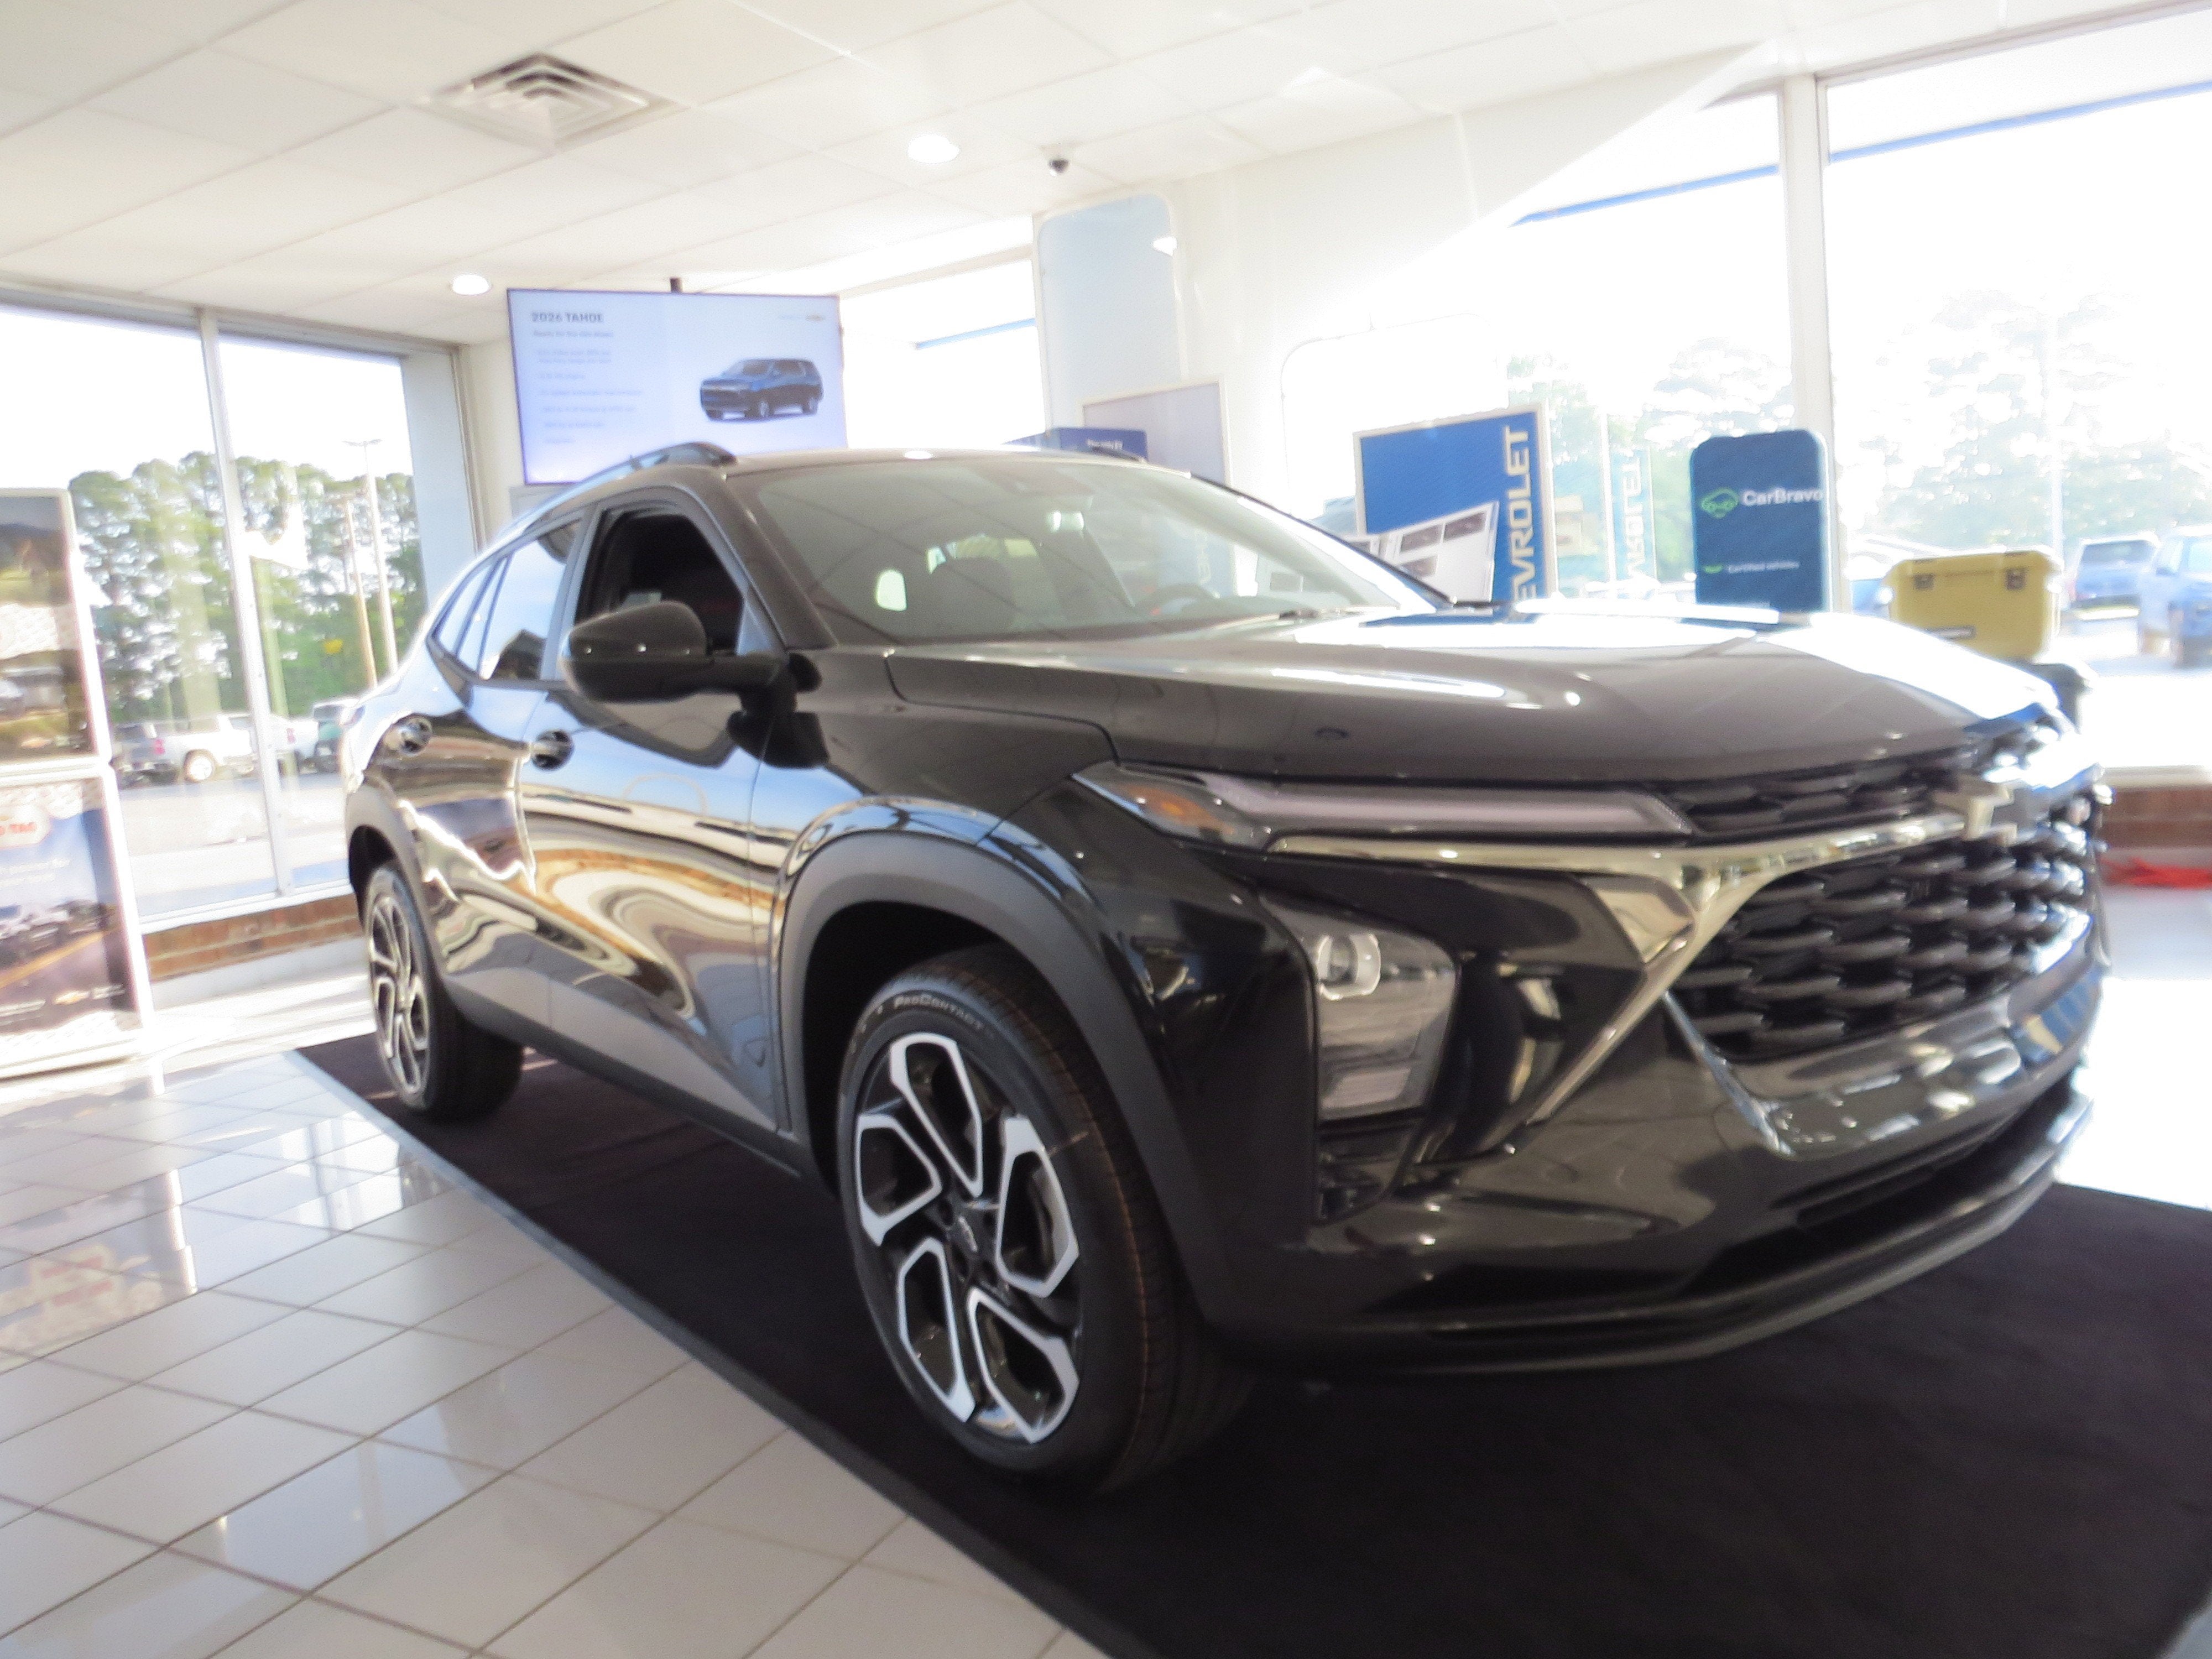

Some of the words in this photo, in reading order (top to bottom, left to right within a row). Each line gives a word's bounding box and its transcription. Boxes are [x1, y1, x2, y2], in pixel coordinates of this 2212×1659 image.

[532, 312, 562, 322] 2026
[565, 312, 603, 323] TAHOE
[1742, 487, 1824, 507] CarBravo
